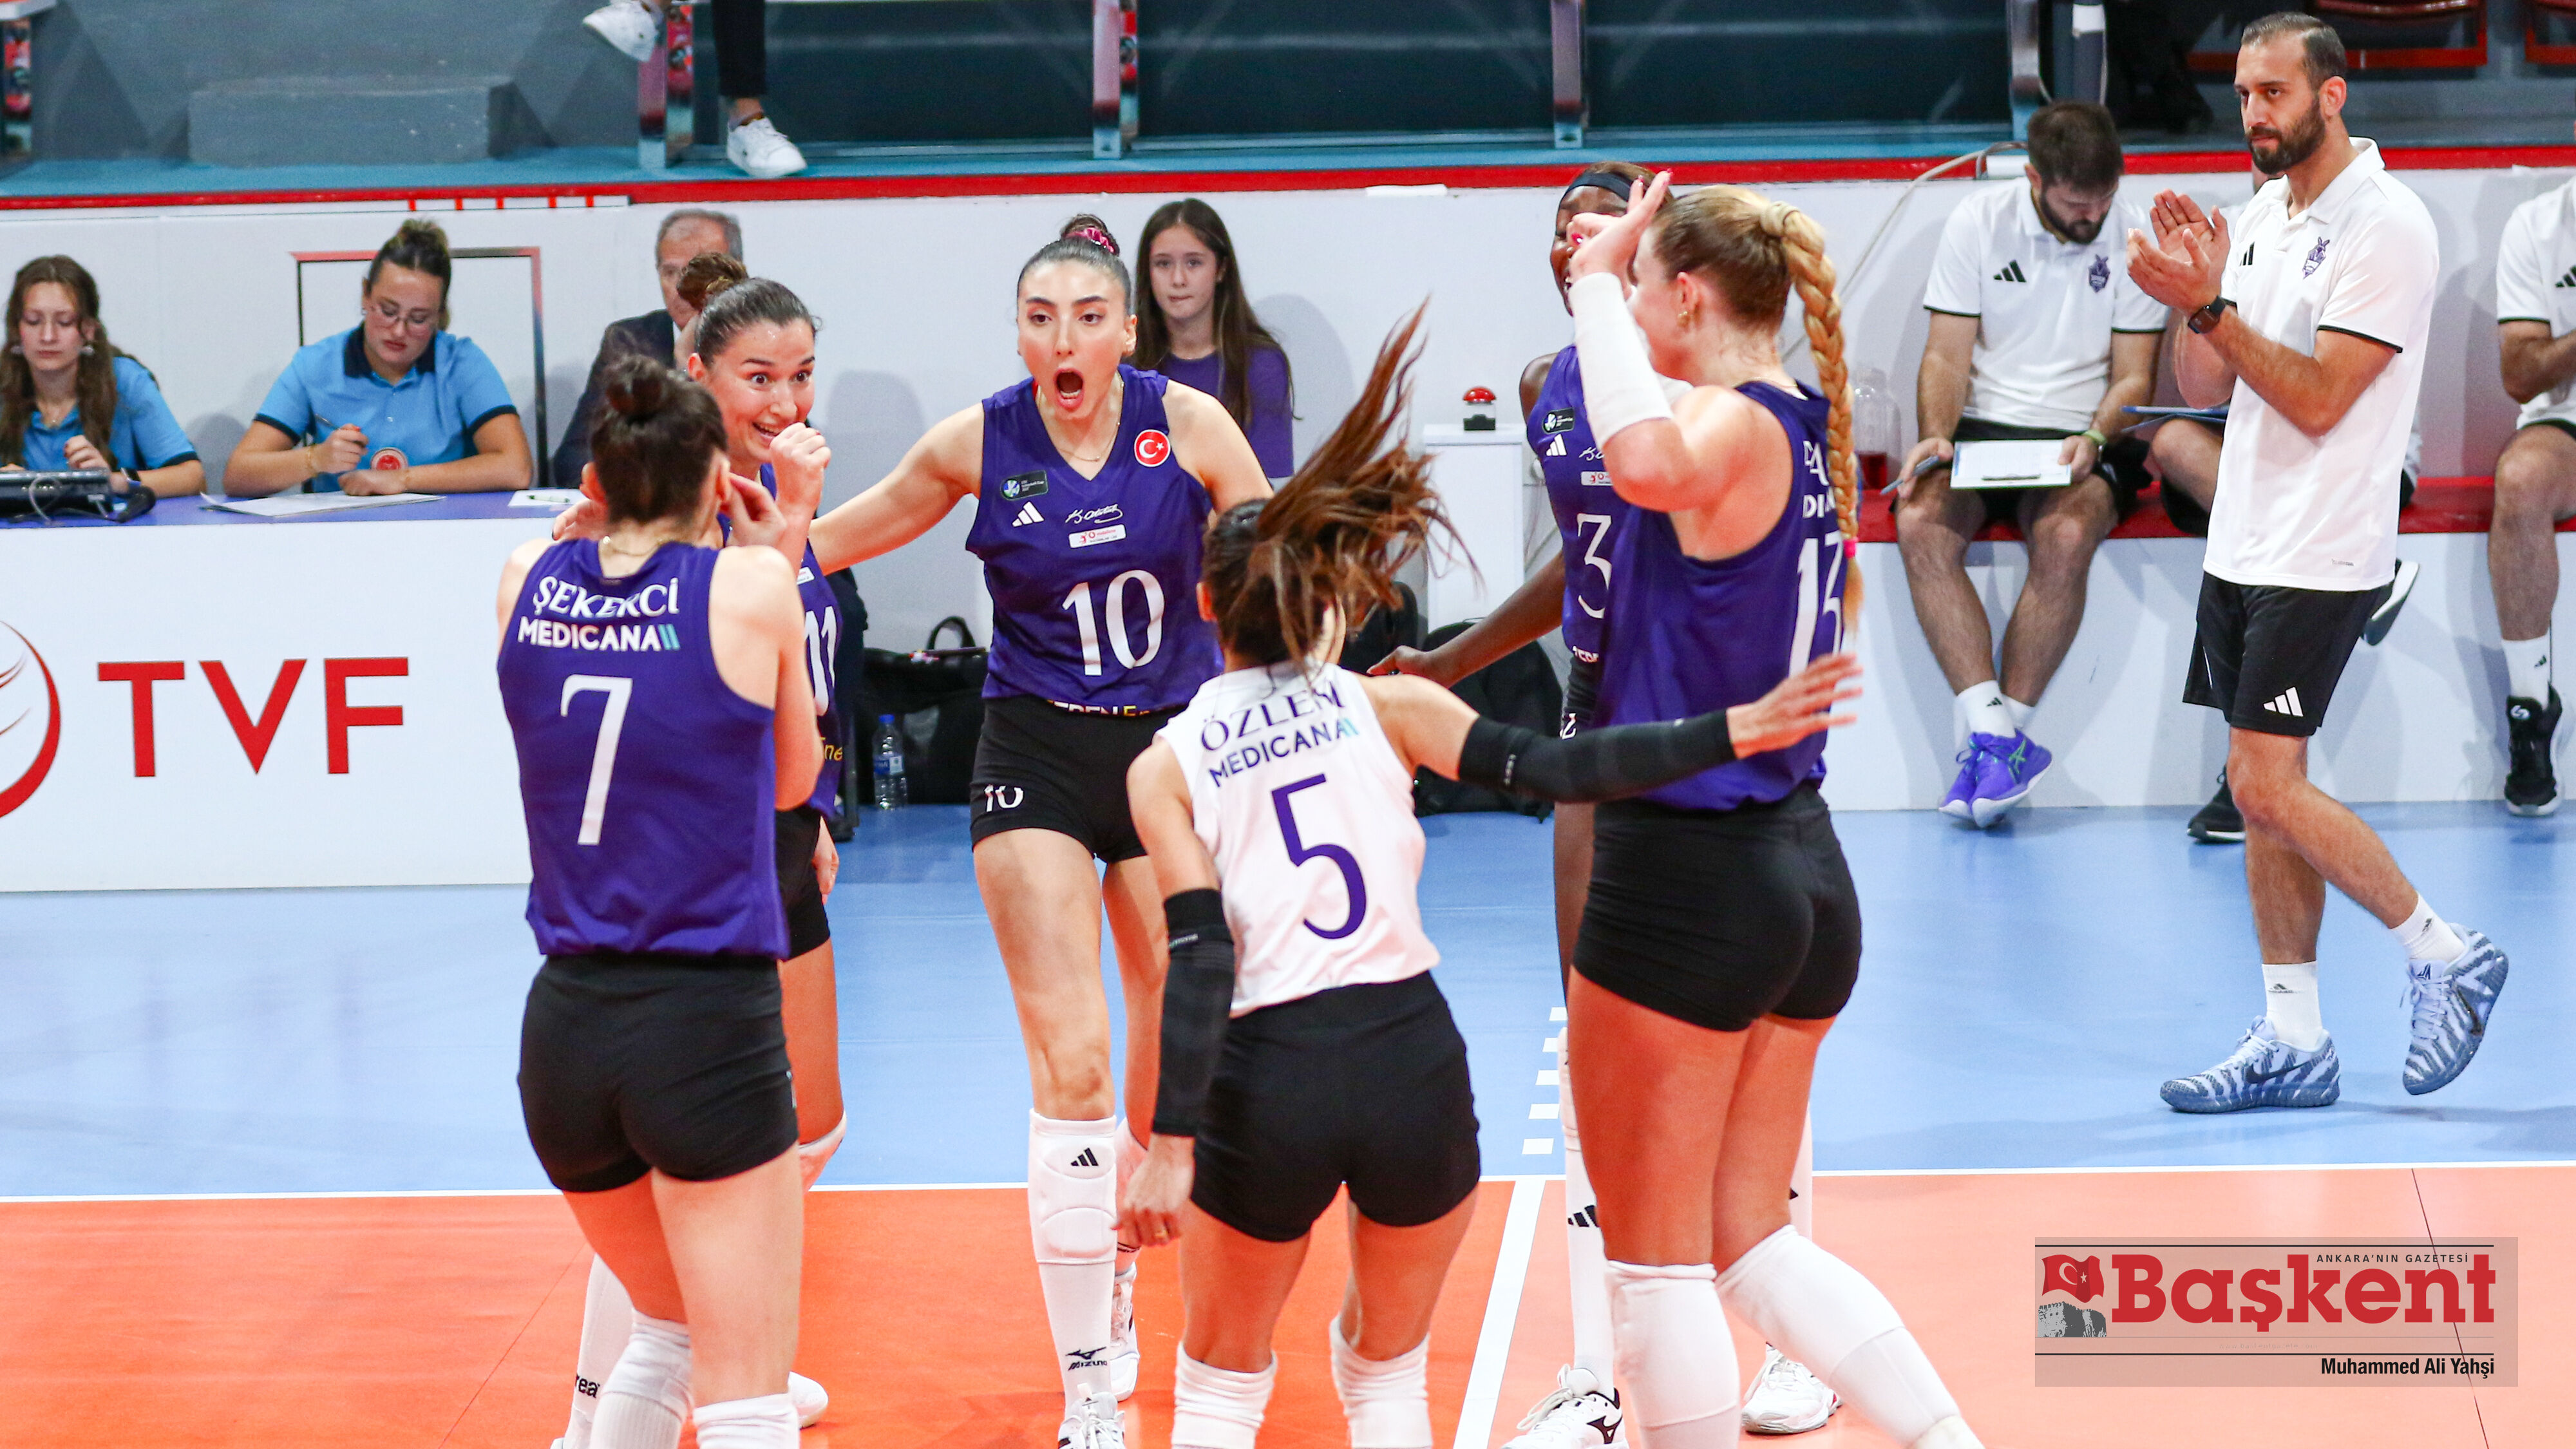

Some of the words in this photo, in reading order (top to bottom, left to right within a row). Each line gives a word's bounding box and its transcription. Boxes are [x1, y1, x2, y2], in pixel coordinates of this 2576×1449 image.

[518, 616, 662, 652] MEDICANA
[533, 576, 679, 618] ŞEKERCİ
[1062, 570, 1165, 676] 10
[98, 658, 410, 777] TVF
[560, 674, 632, 845] 7
[1208, 718, 1346, 788] MEDICANA
[1271, 773, 1366, 940] 5
